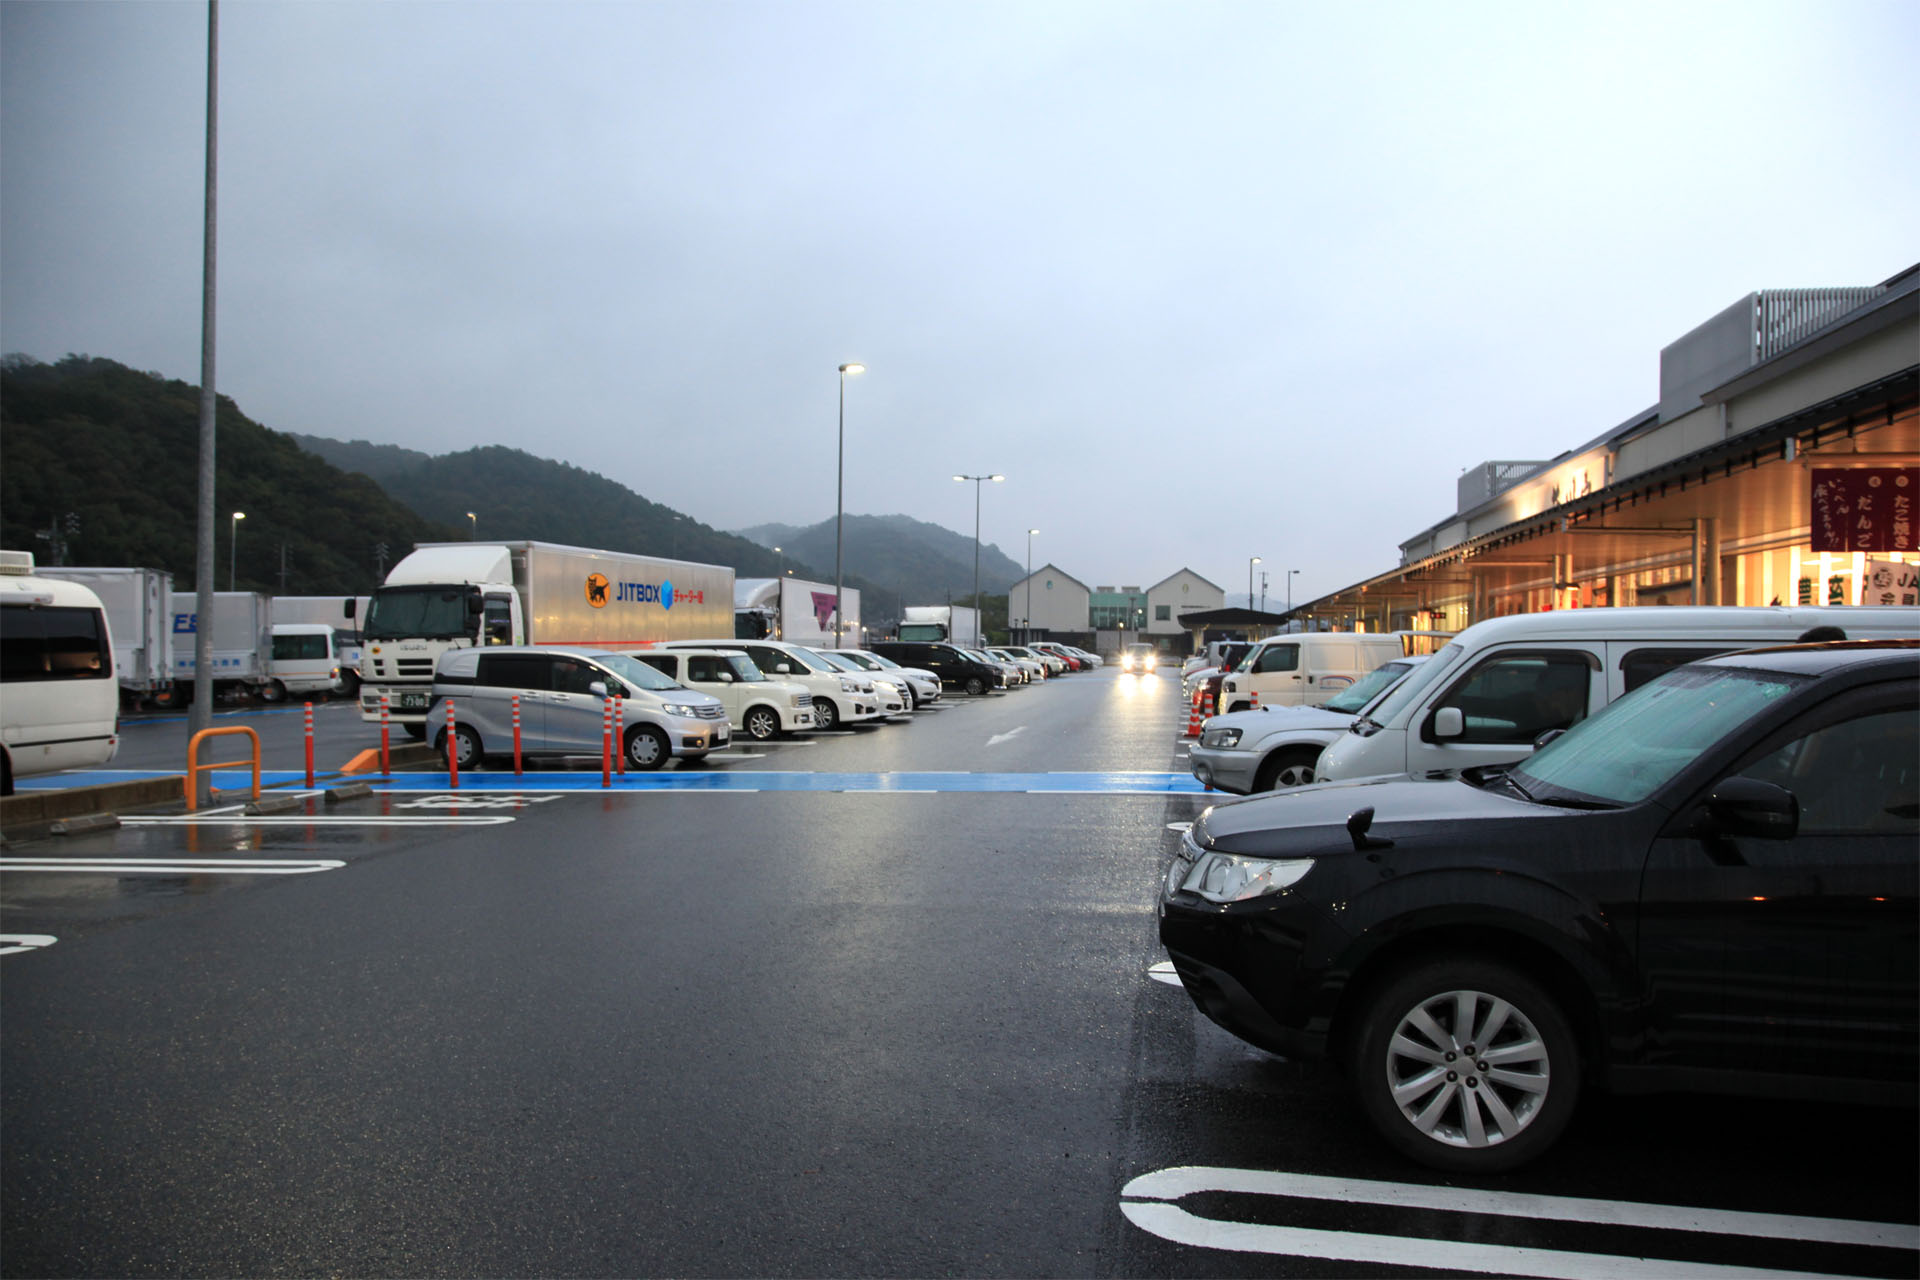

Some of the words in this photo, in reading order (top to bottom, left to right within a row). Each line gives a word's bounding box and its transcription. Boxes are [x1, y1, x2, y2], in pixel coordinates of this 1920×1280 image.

[1857, 494, 1873, 548] だんご
[1893, 494, 1910, 549] たこ焼き
[616, 582, 660, 603] JITBOX
[1897, 572, 1919, 588] JA
